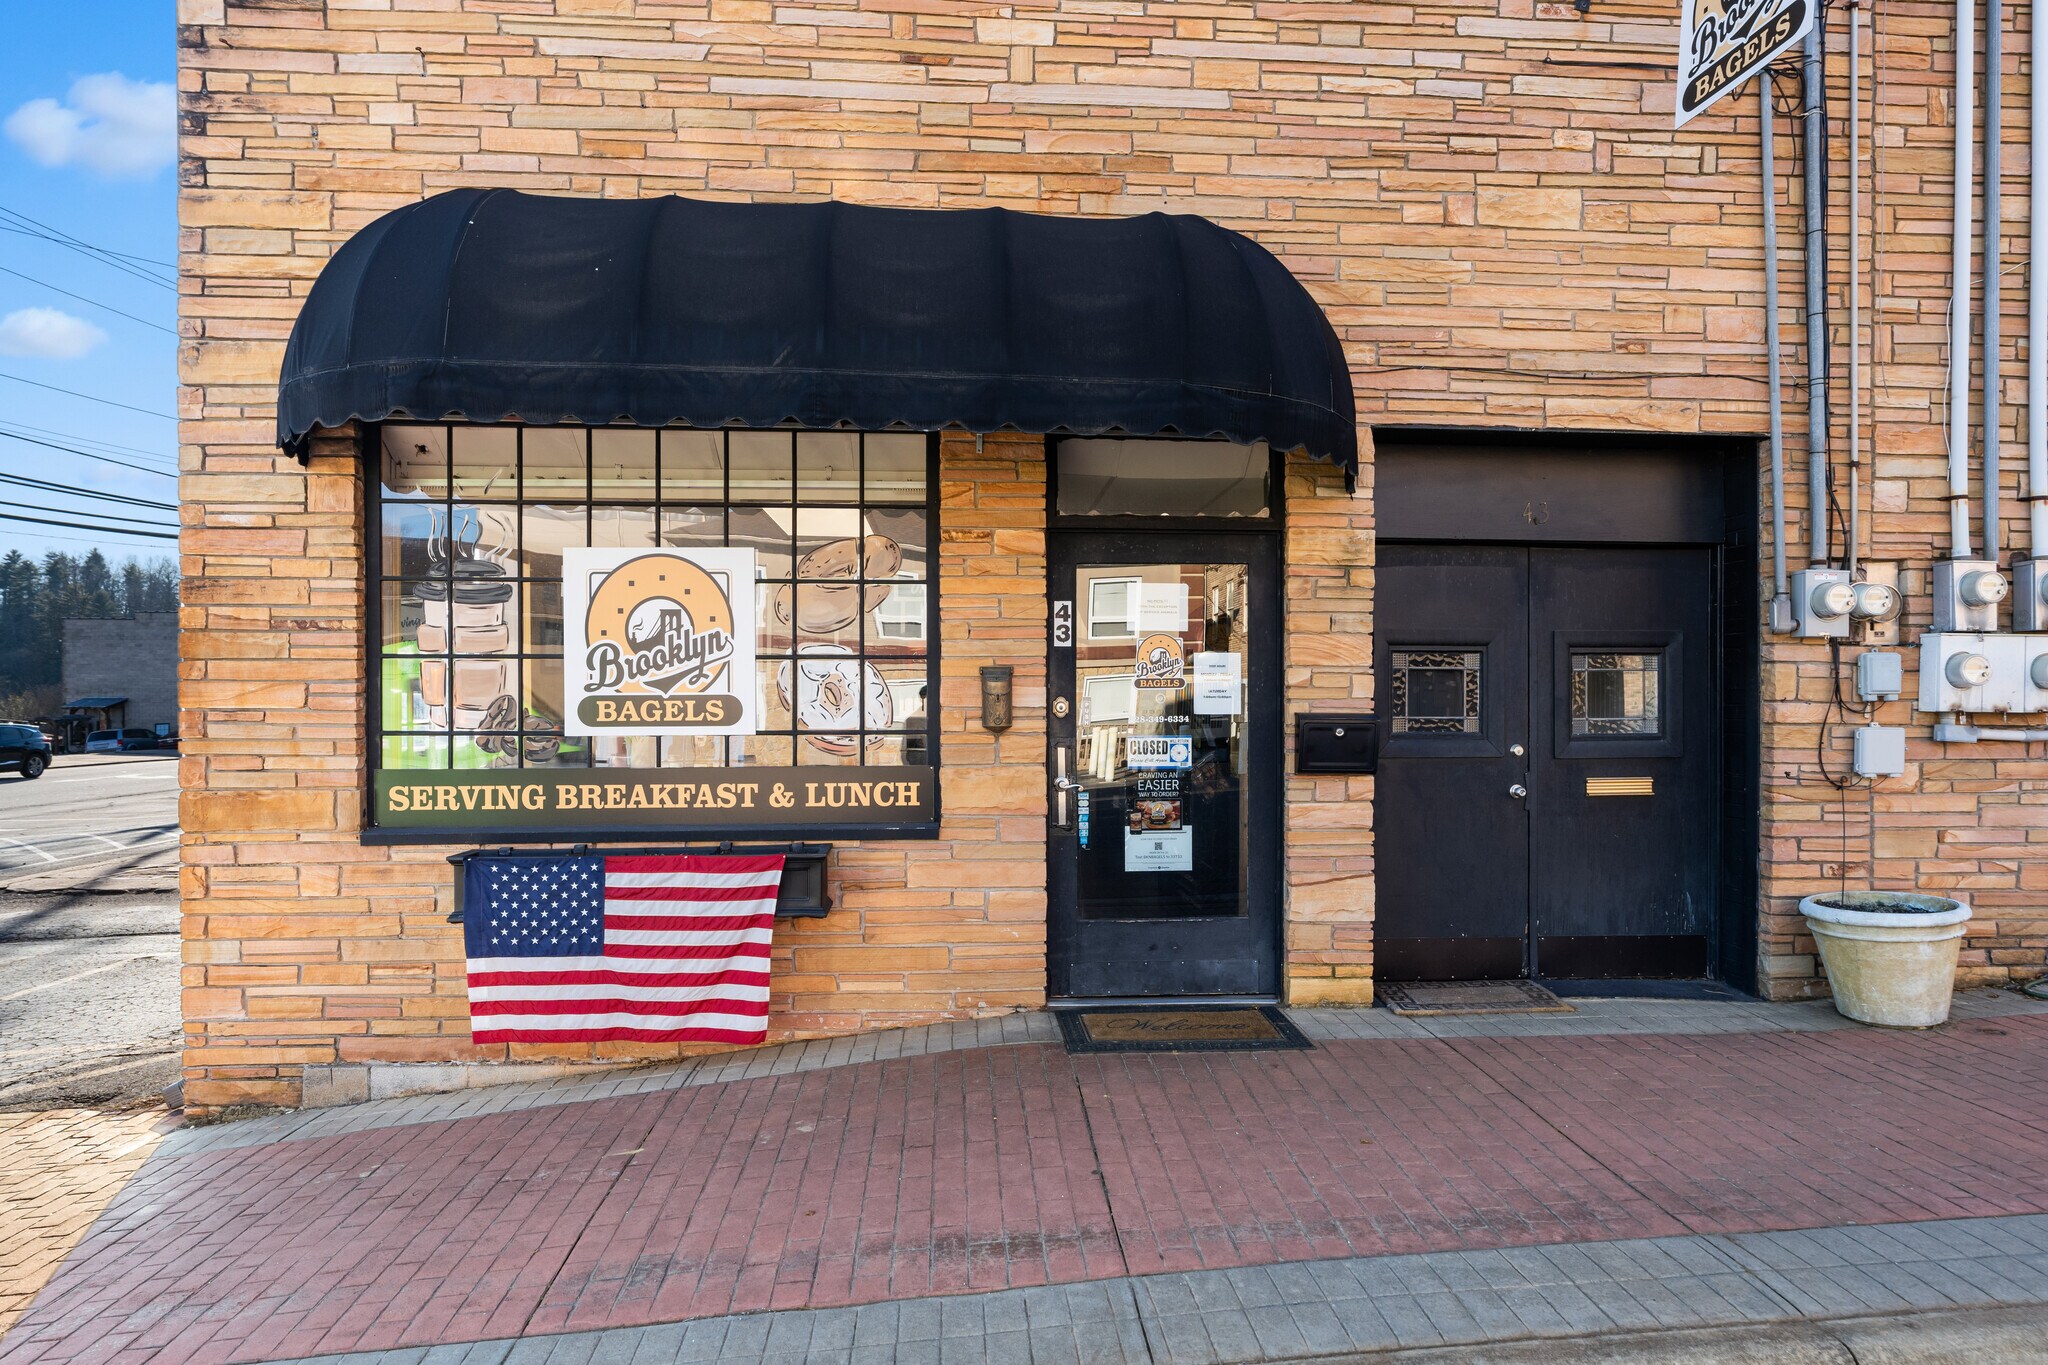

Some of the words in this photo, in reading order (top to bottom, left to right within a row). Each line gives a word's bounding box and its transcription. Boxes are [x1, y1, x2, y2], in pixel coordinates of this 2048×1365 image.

[1695, 12, 1790, 103] BAGELS
[1522, 501, 1550, 526] 43
[1055, 604, 1071, 643] 43
[584, 630, 734, 692] Brooklyn
[1136, 657, 1184, 678] Brooklyn
[1140, 679, 1180, 687] BAGELS
[596, 700, 724, 722] BAGELS
[1130, 715, 1190, 723] 28-349-6334
[1130, 740, 1169, 755] CLOSED
[1137, 779, 1180, 790] EASIER
[388, 784, 547, 812] SERVING
[555, 783, 759, 810] BREAKFAST
[768, 782, 795, 808] &
[805, 781, 921, 807] LUNCH
[1106, 1018, 1250, 1031] Welcome
